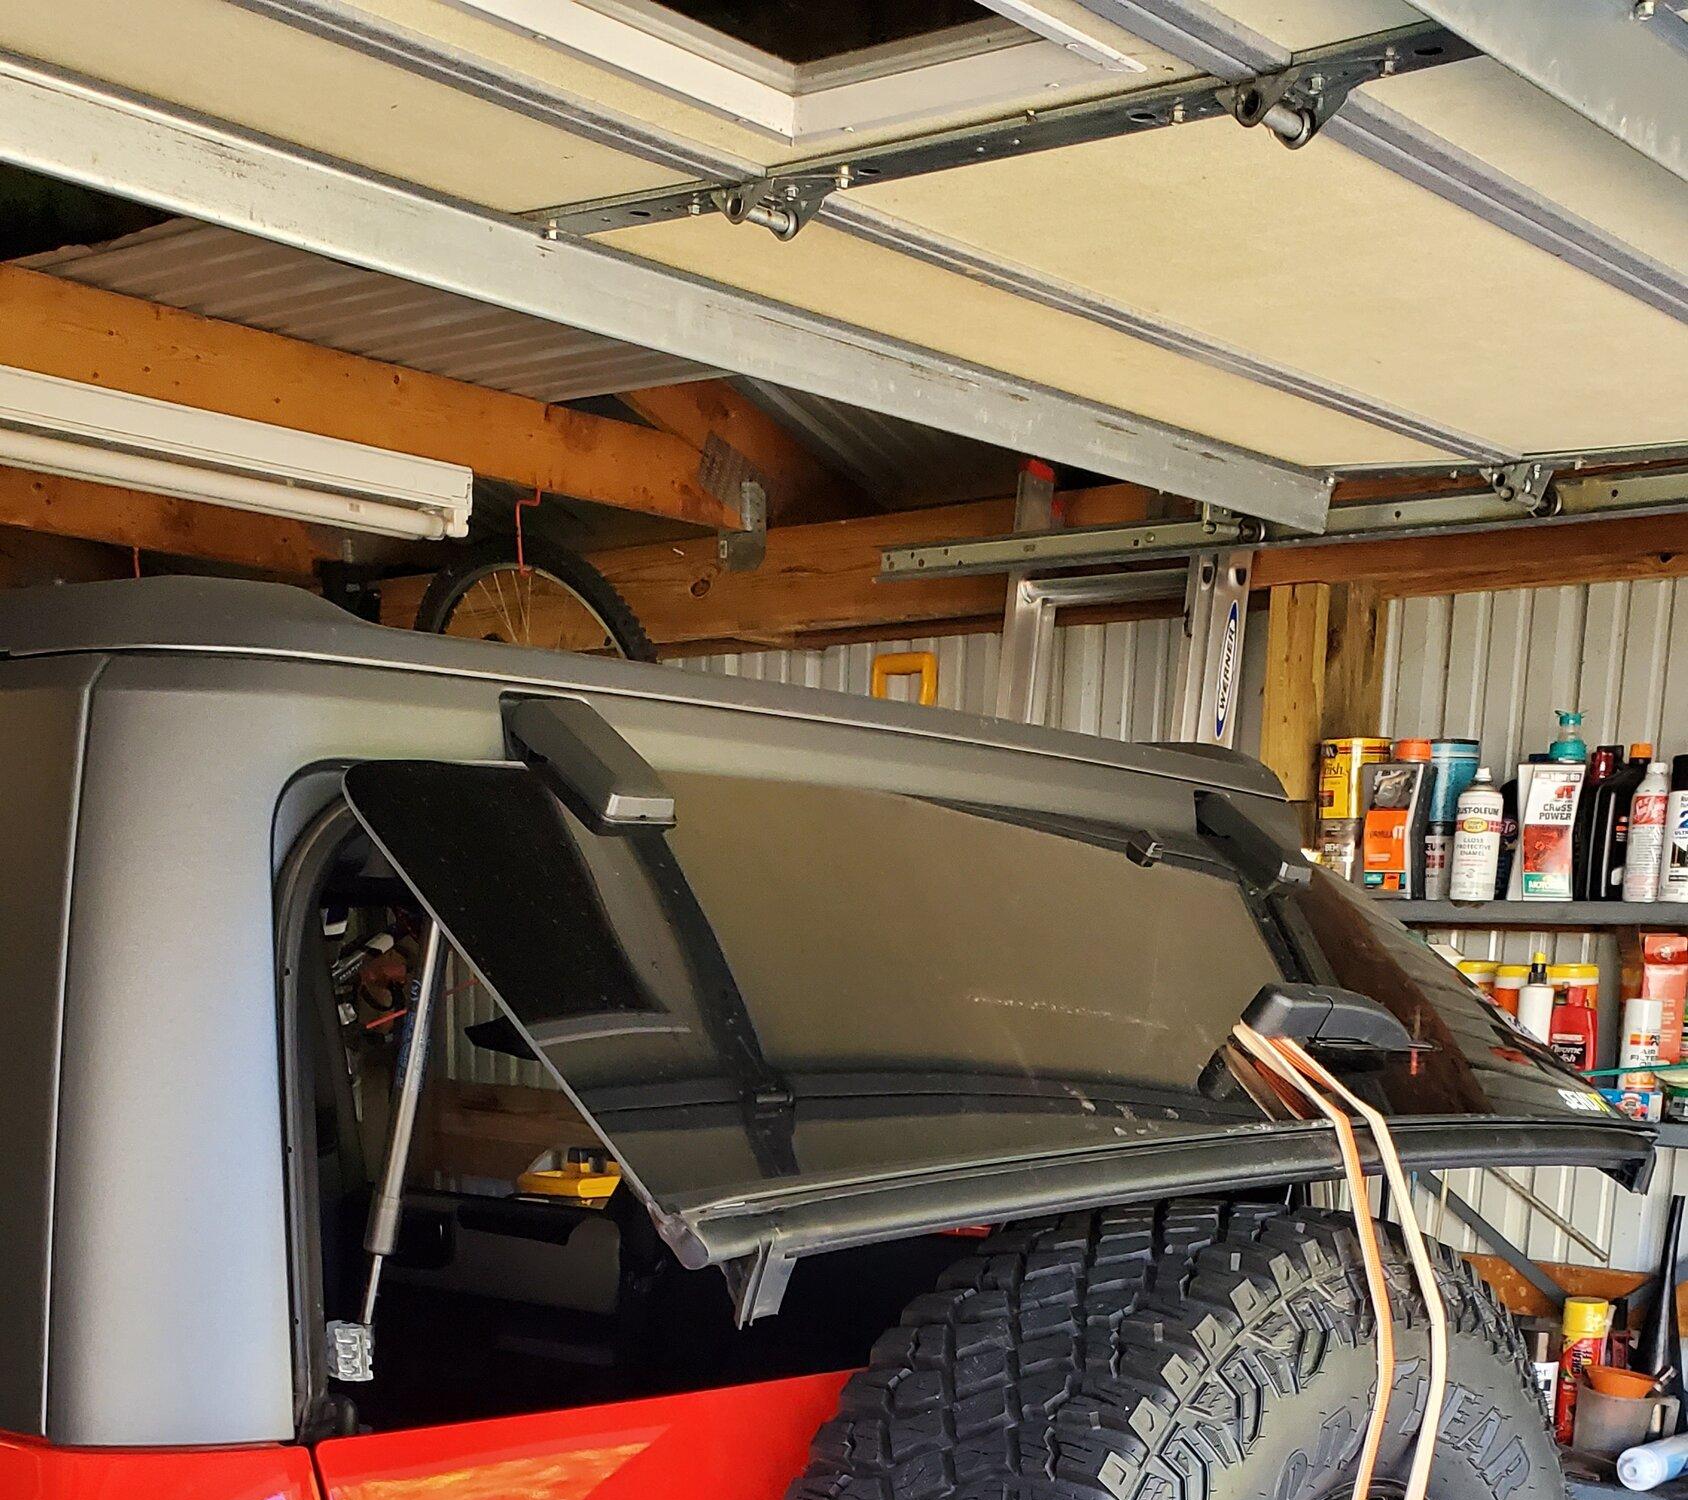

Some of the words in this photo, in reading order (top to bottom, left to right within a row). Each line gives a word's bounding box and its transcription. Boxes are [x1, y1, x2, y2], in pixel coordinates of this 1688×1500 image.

[1218, 624, 1236, 710] WERNER
[1543, 803, 1573, 812] CROSS
[1539, 812, 1572, 820] POWER
